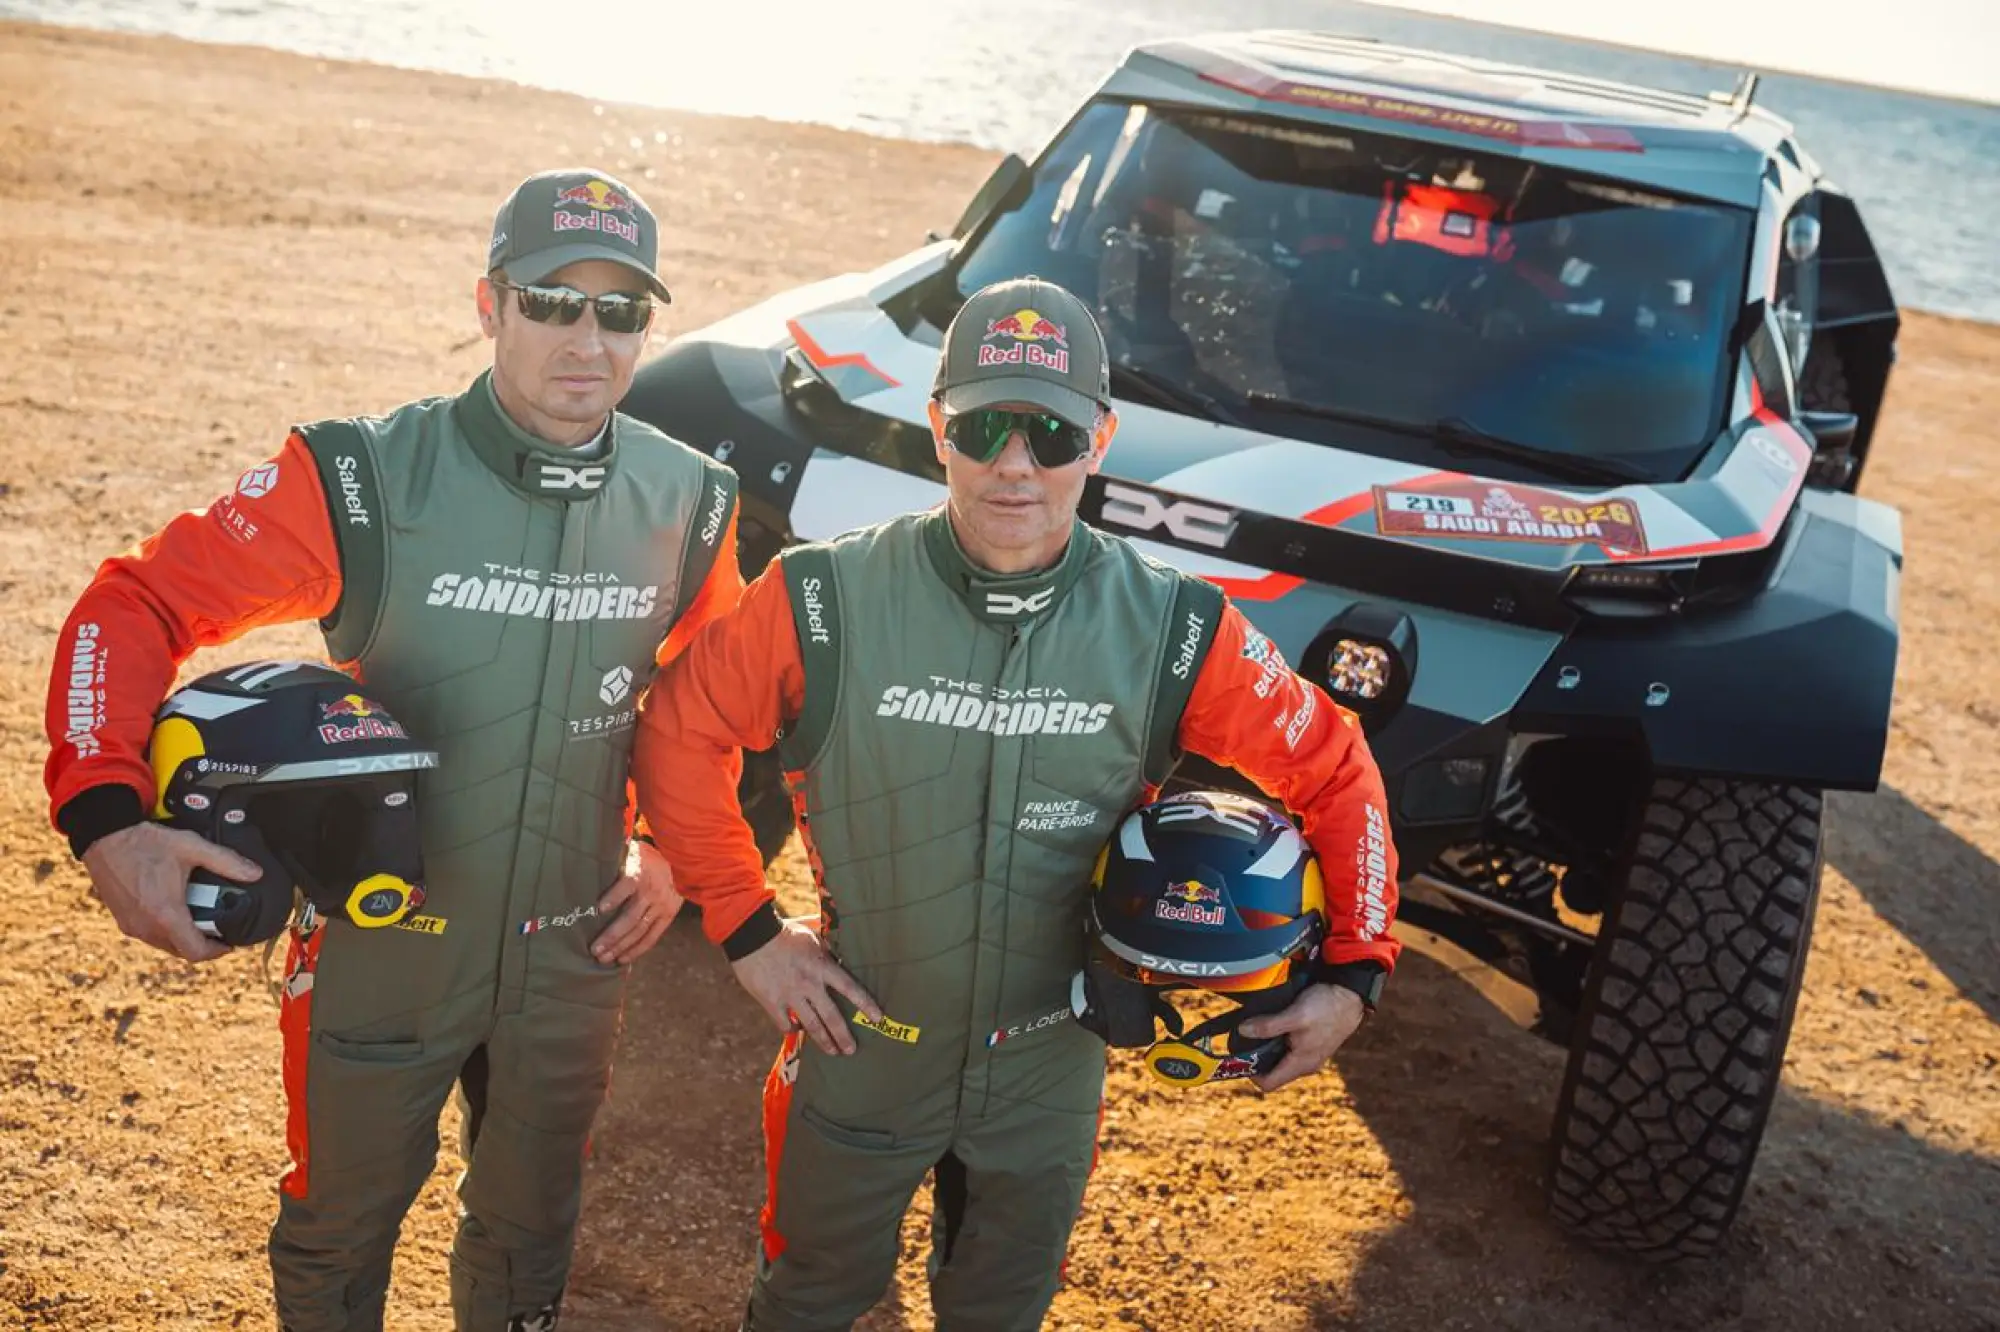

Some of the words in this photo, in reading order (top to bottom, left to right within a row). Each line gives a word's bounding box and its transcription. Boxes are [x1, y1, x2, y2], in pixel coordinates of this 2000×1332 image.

[554, 211, 597, 232] Red
[602, 213, 639, 247] Bull
[978, 342, 1023, 366] Red
[1026, 344, 1069, 374] Bull
[335, 455, 371, 527] Sabelt
[700, 484, 730, 547] Sabelt
[1406, 495, 1456, 513] 219
[1540, 502, 1633, 526] 2026
[1423, 513, 1499, 534] SAUDI
[1506, 520, 1603, 538] ARABIA
[484, 562, 541, 580] THE
[549, 571, 621, 585] DACIA
[425, 572, 659, 622] SANDRIDERS
[801, 577, 830, 646] Sabelt
[1172, 613, 1206, 680] Sabelt
[930, 675, 983, 694] THE
[991, 685, 1068, 699] DACIA
[569, 708, 637, 733] RESPIRE
[876, 686, 1115, 737] SANDRIDERS
[318, 717, 368, 745] Red
[210, 761, 258, 776] RESPIRE
[336, 752, 434, 775] DACIA
[1016, 809, 1099, 831] PARE-BRISE
[1023, 799, 1080, 814] FRANCE
[1156, 899, 1191, 921] Red
[1192, 904, 1227, 926] Bull
[1140, 954, 1228, 976] DACIA
